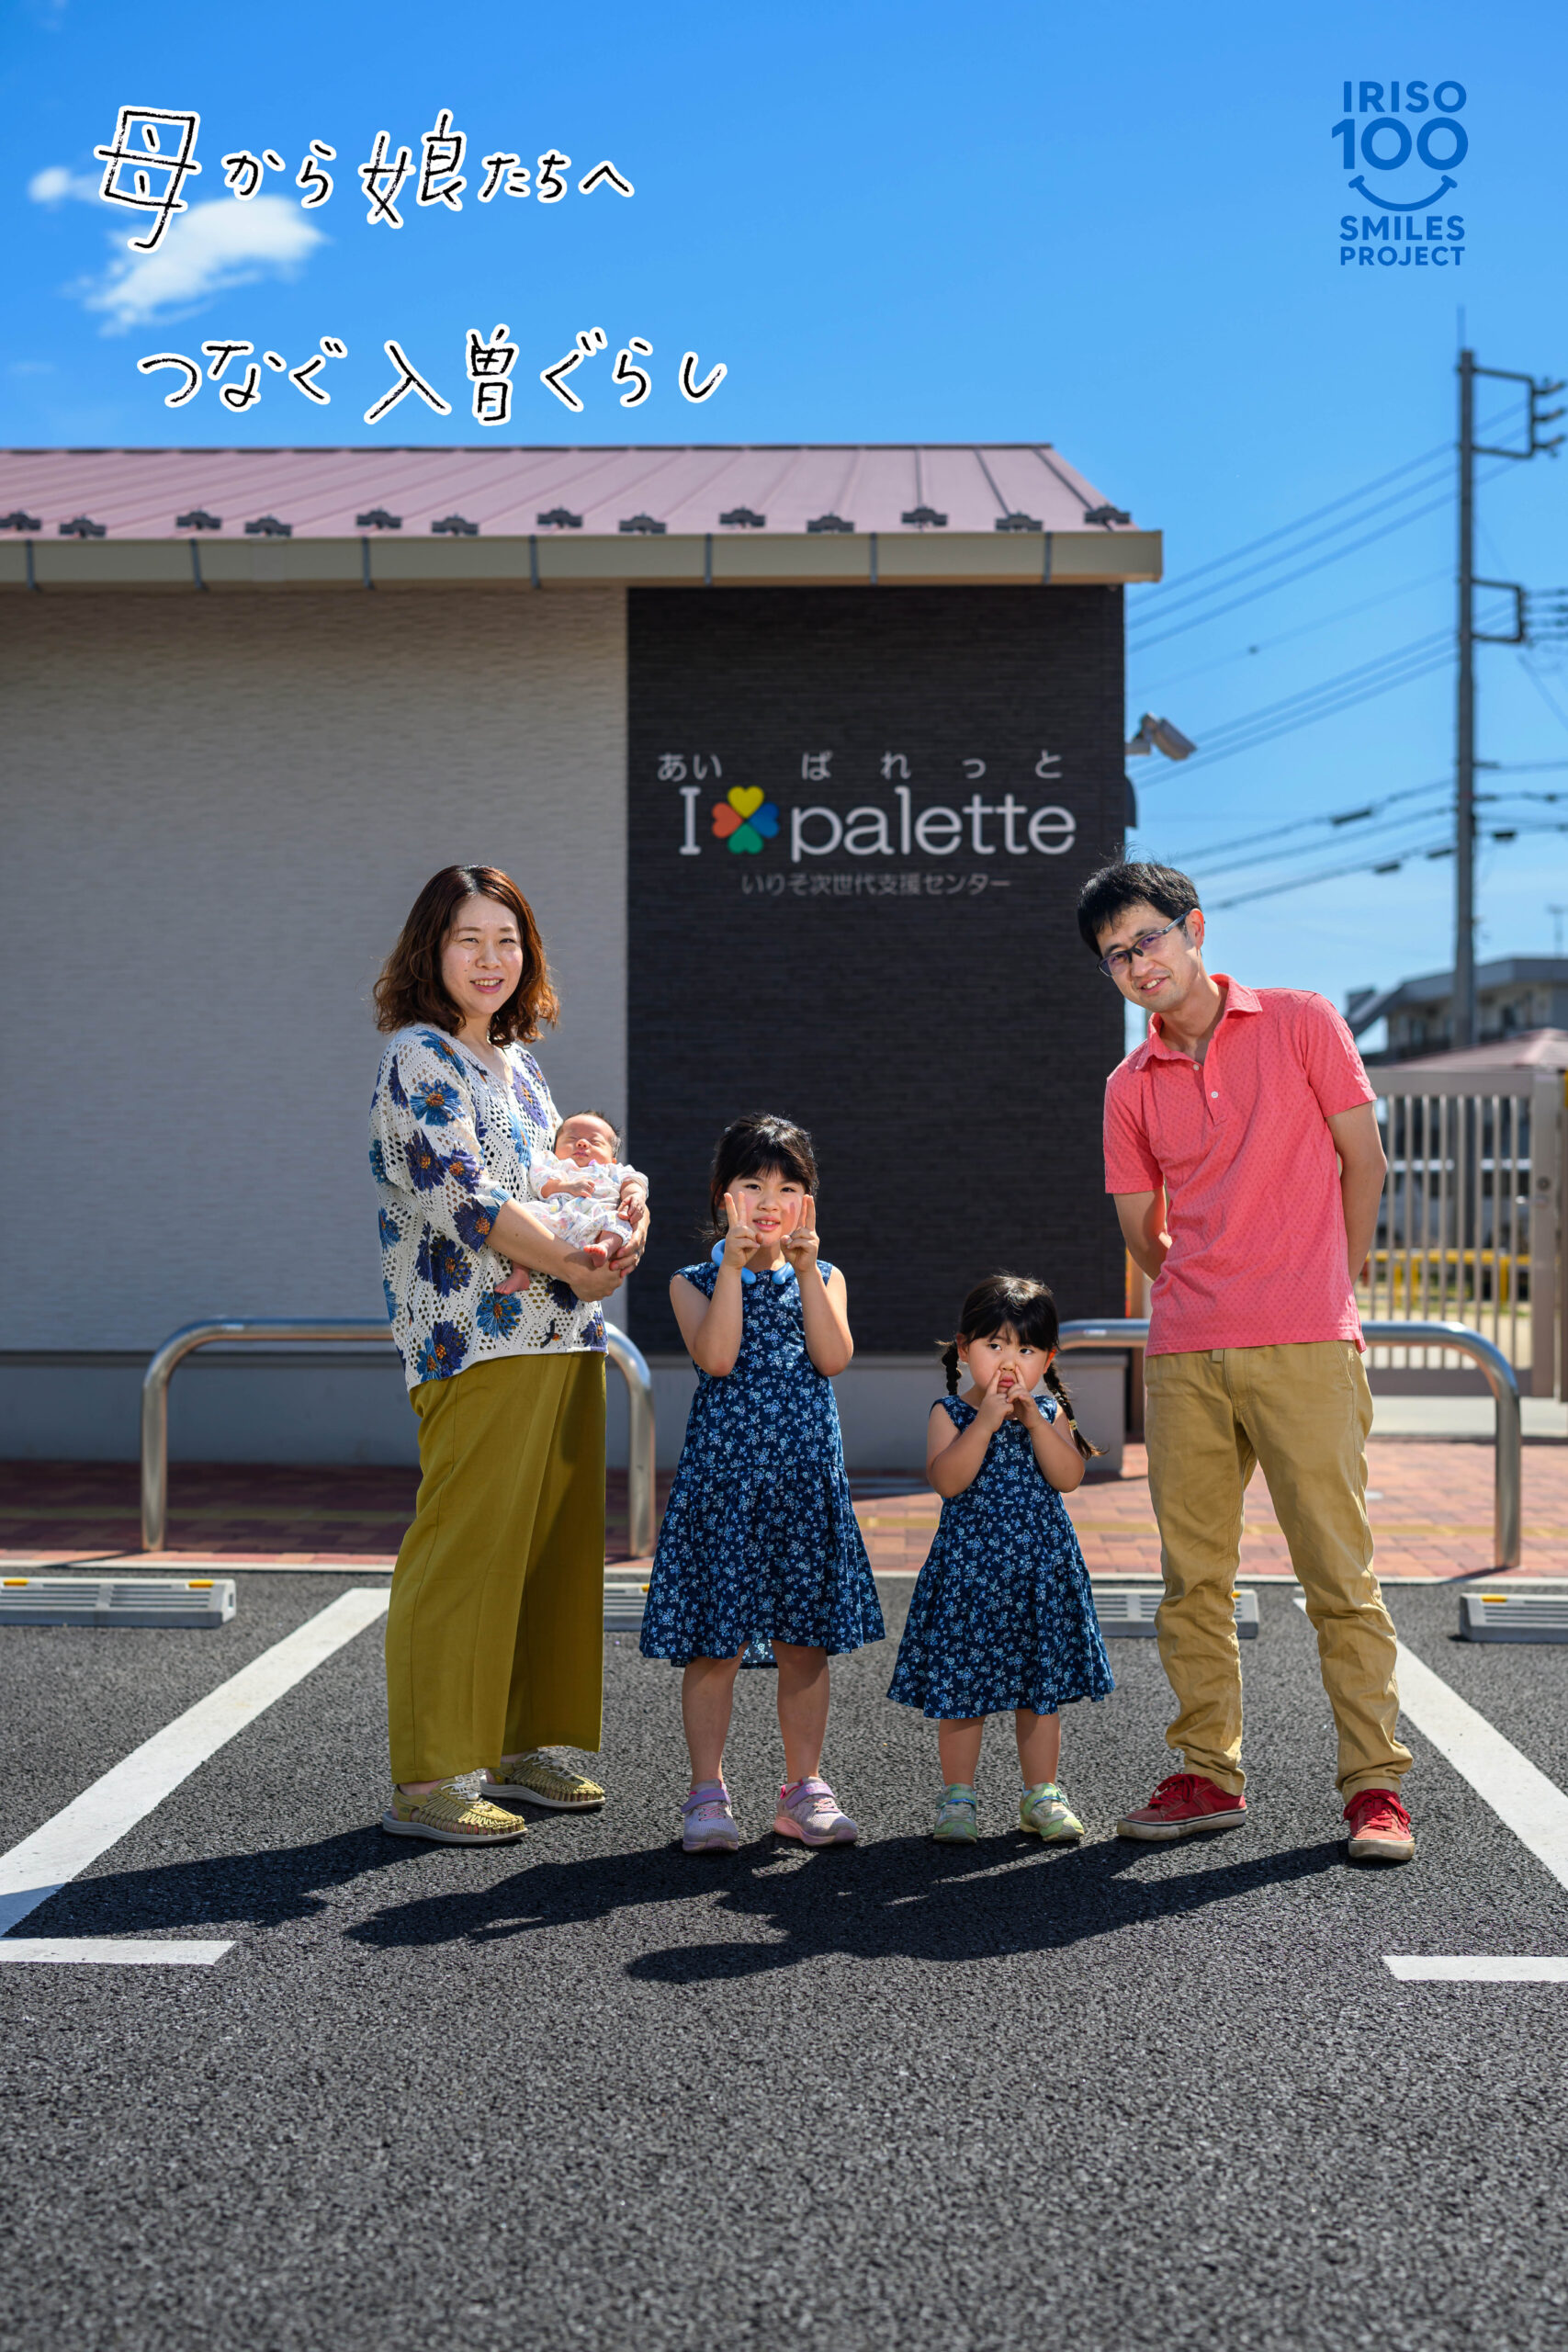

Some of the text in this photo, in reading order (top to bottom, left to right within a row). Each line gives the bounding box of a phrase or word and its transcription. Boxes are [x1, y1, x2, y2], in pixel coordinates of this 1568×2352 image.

[679, 786, 1077, 863] I palette
[740, 872, 1011, 897] いりそ次世代支援センター
